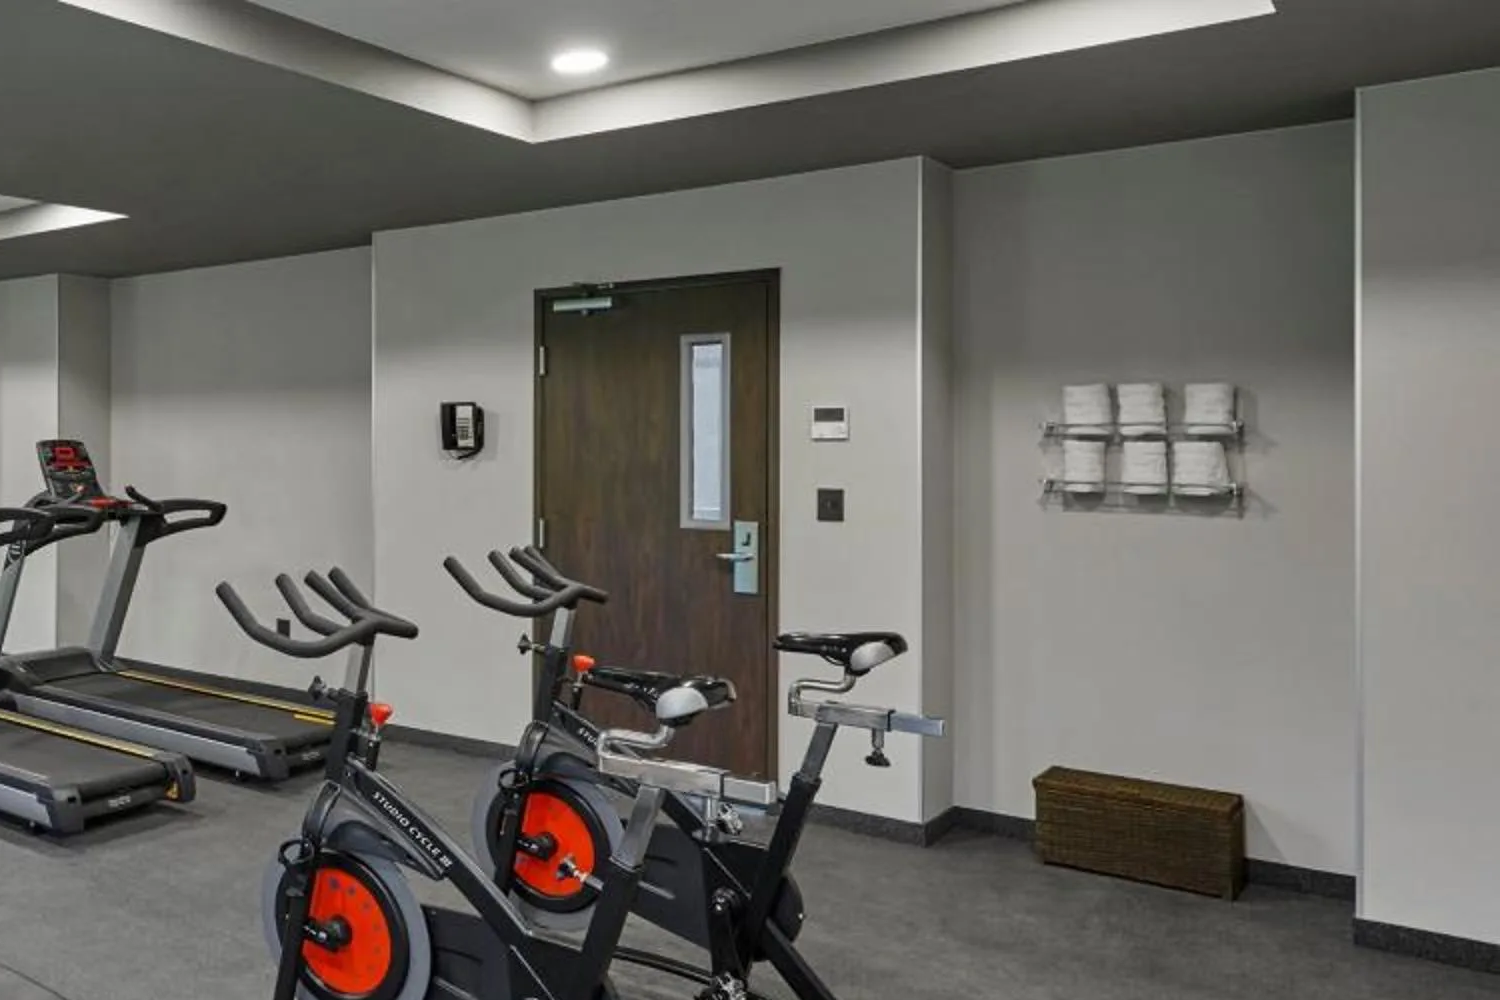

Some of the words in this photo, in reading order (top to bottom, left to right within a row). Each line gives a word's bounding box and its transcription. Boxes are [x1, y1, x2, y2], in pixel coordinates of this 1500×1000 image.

[578, 727, 598, 747] STU
[372, 791, 410, 827] STUDIO
[408, 827, 441, 856] CYCLE
